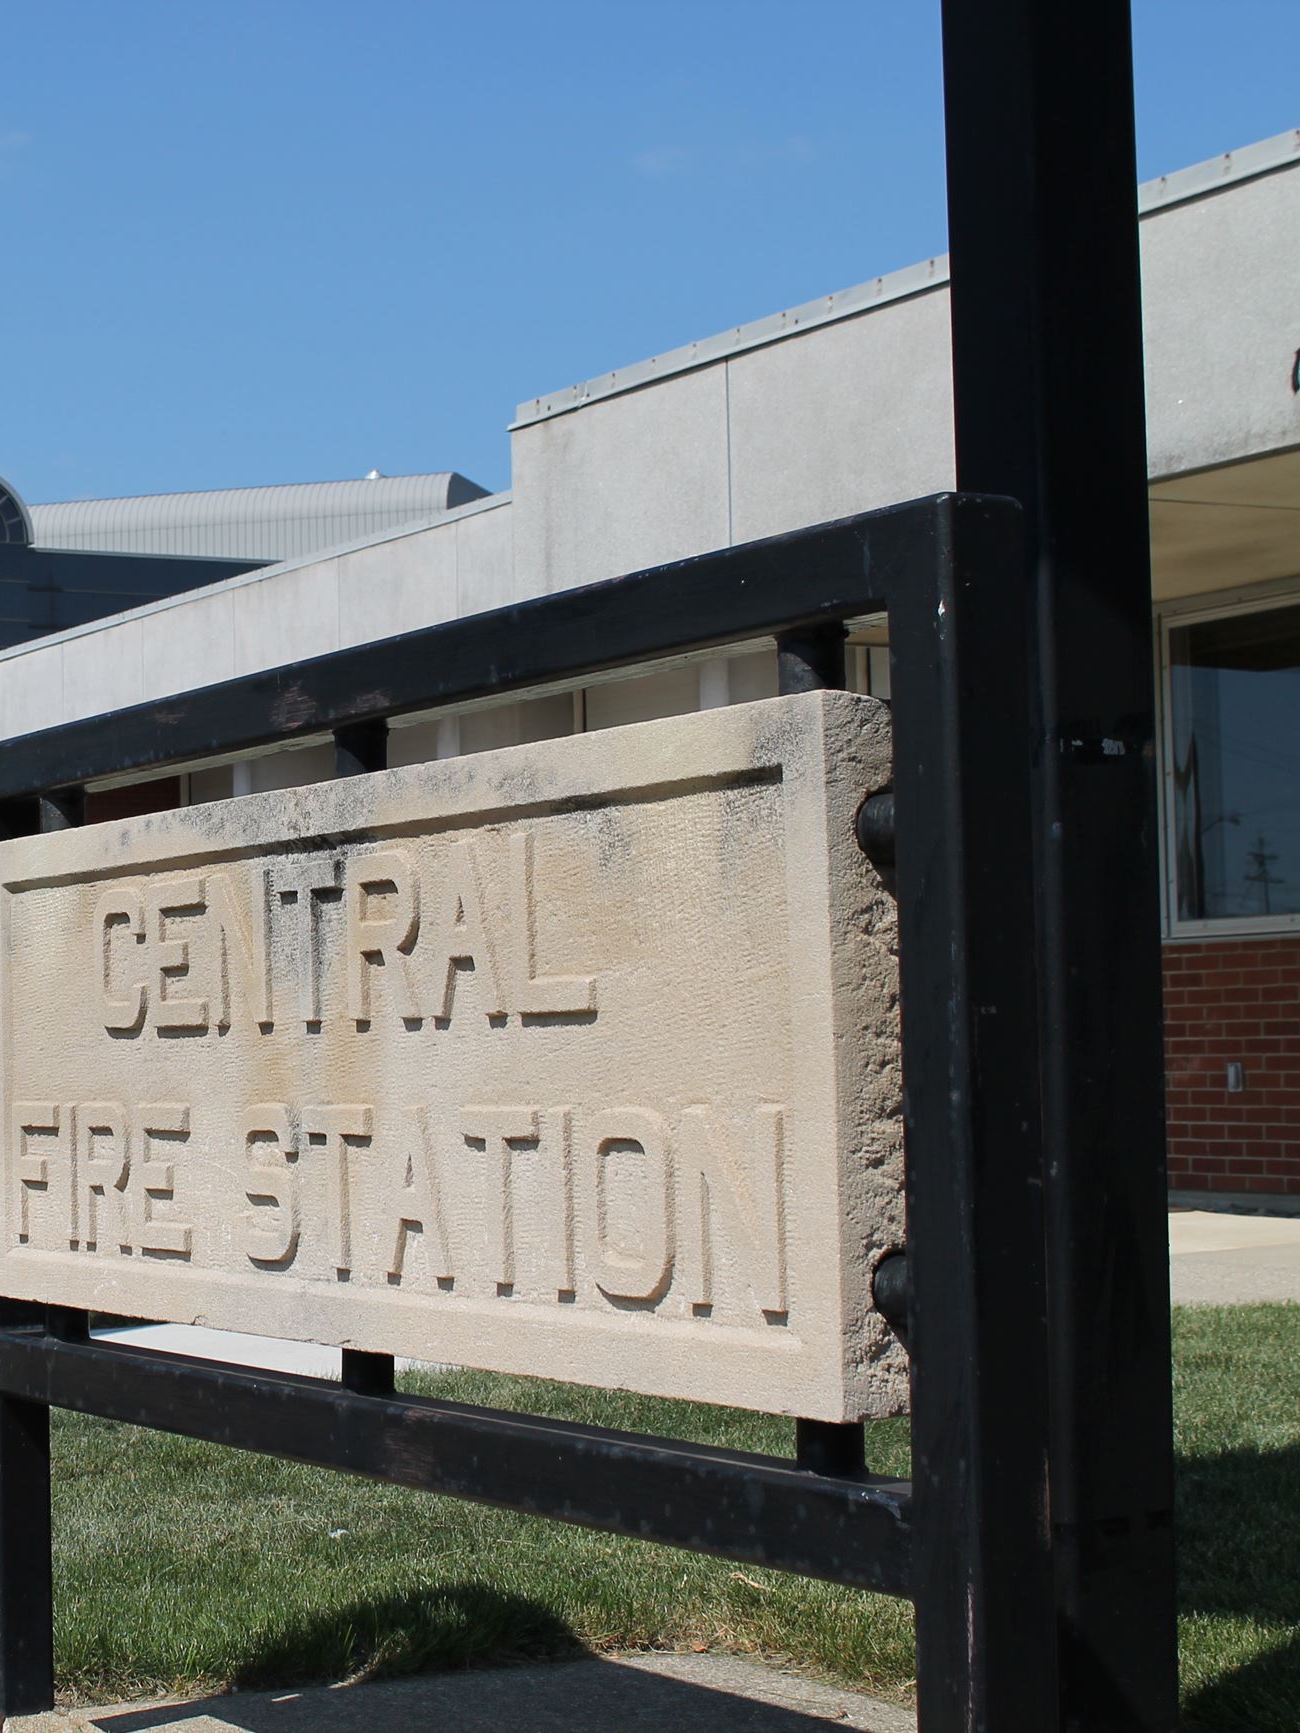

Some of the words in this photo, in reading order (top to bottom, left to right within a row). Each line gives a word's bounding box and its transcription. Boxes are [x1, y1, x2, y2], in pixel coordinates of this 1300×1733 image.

[94, 828, 599, 1037] CENTRAL
[13, 1102, 192, 1263] FIRE
[243, 1102, 788, 1326] STATION
